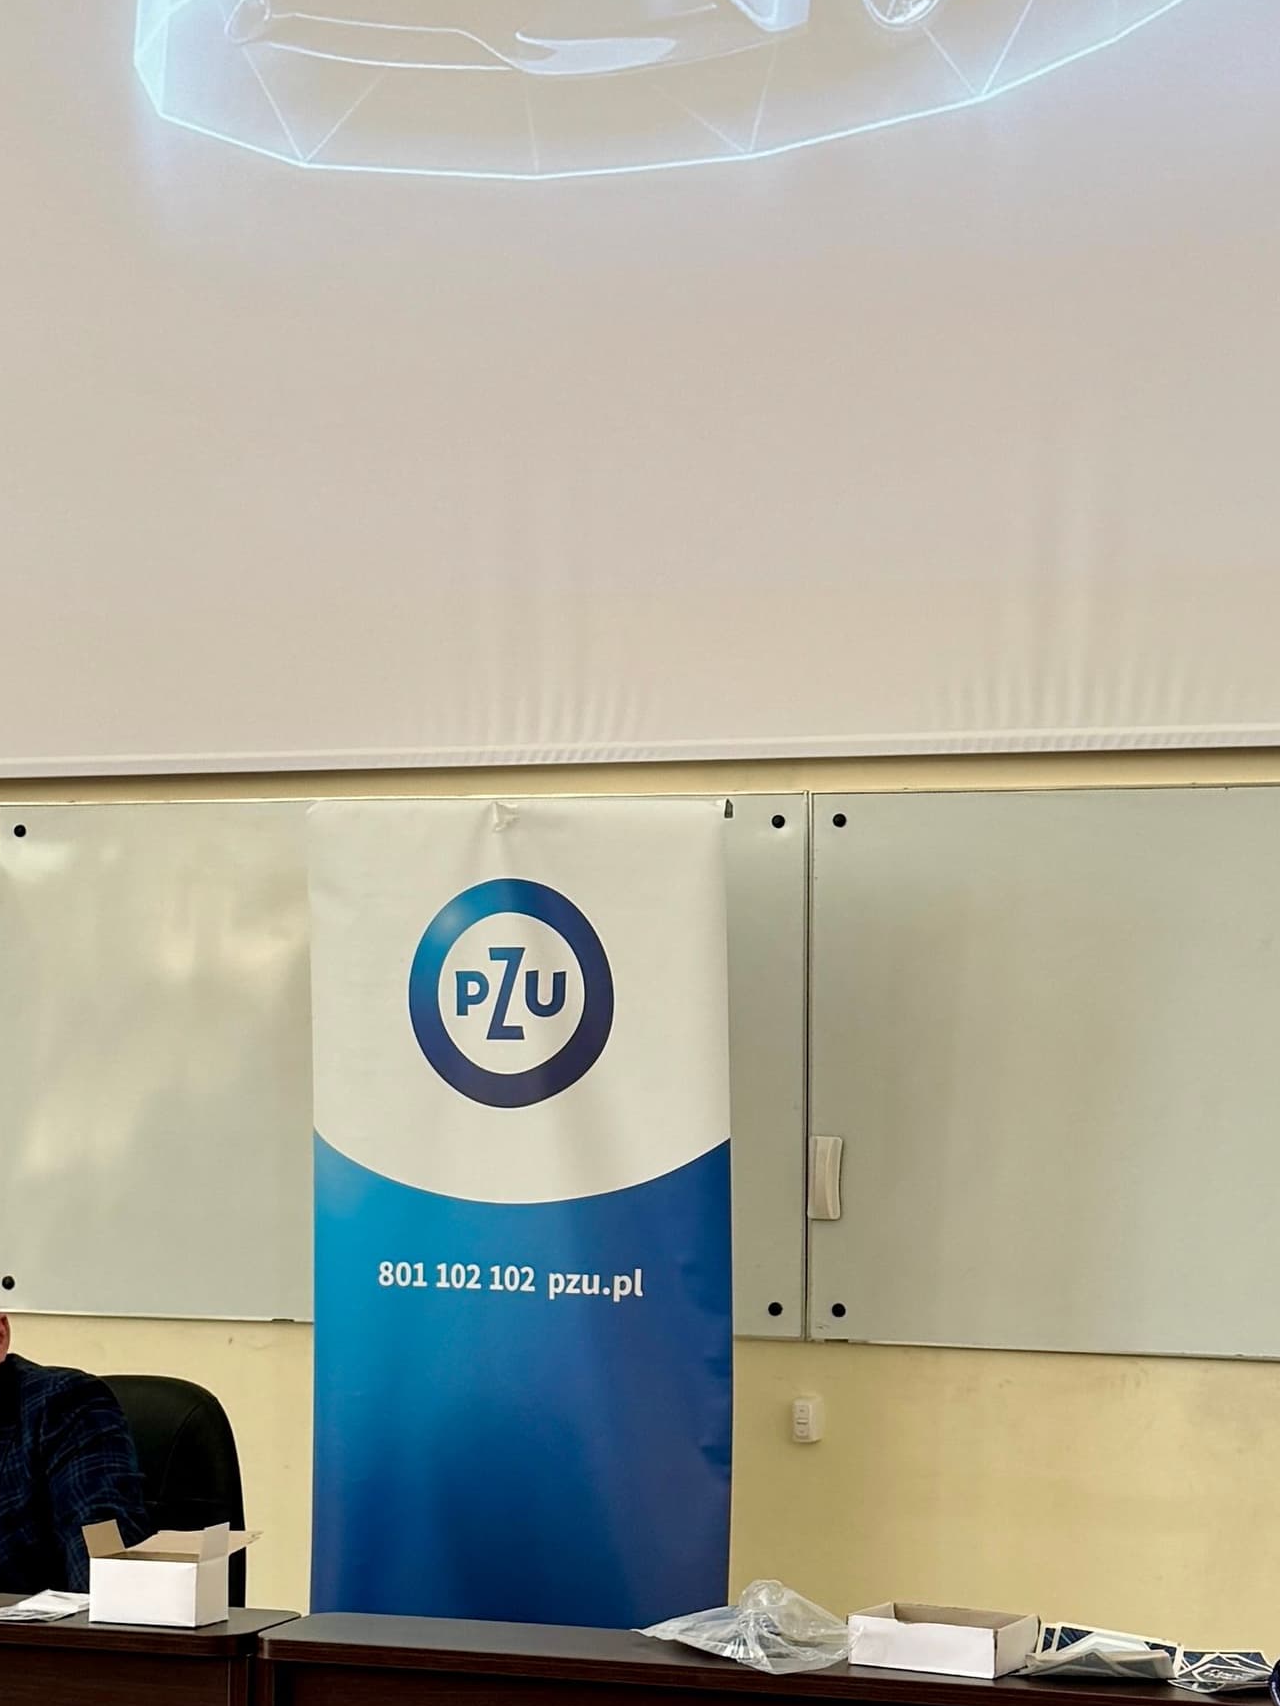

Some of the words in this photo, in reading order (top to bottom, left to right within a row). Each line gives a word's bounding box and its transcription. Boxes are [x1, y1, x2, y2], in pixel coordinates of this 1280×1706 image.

[455, 947, 567, 1040] PZU
[378, 1261, 428, 1287] 801
[436, 1263, 482, 1289] 102
[489, 1266, 536, 1292] 102
[548, 1269, 643, 1302] pzu.pl
